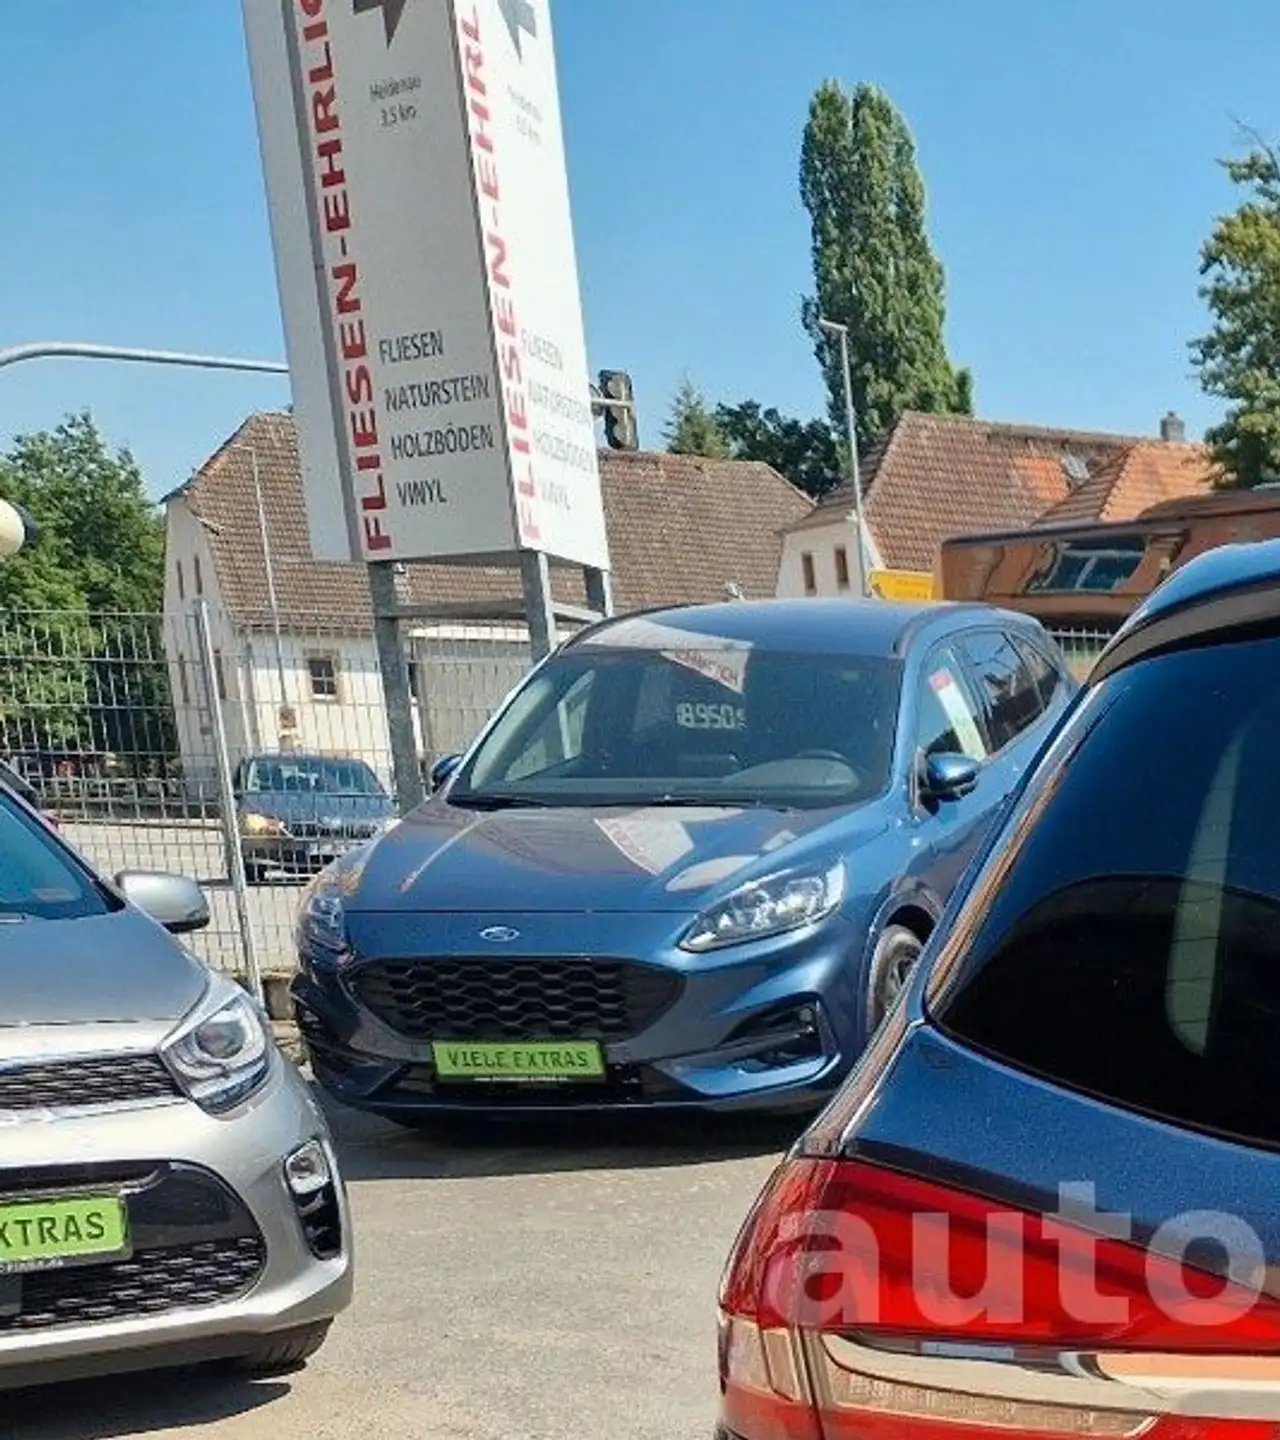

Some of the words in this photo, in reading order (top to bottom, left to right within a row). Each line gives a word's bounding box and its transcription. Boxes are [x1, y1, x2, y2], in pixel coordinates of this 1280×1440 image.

[379, 329, 444, 364] FLIESEN
[385, 373, 490, 412] NATURSTEIN
[396, 477, 448, 506] VINYL
[447, 1048, 506, 1067] VIELE
[512, 1049, 589, 1067] EXTRAS
